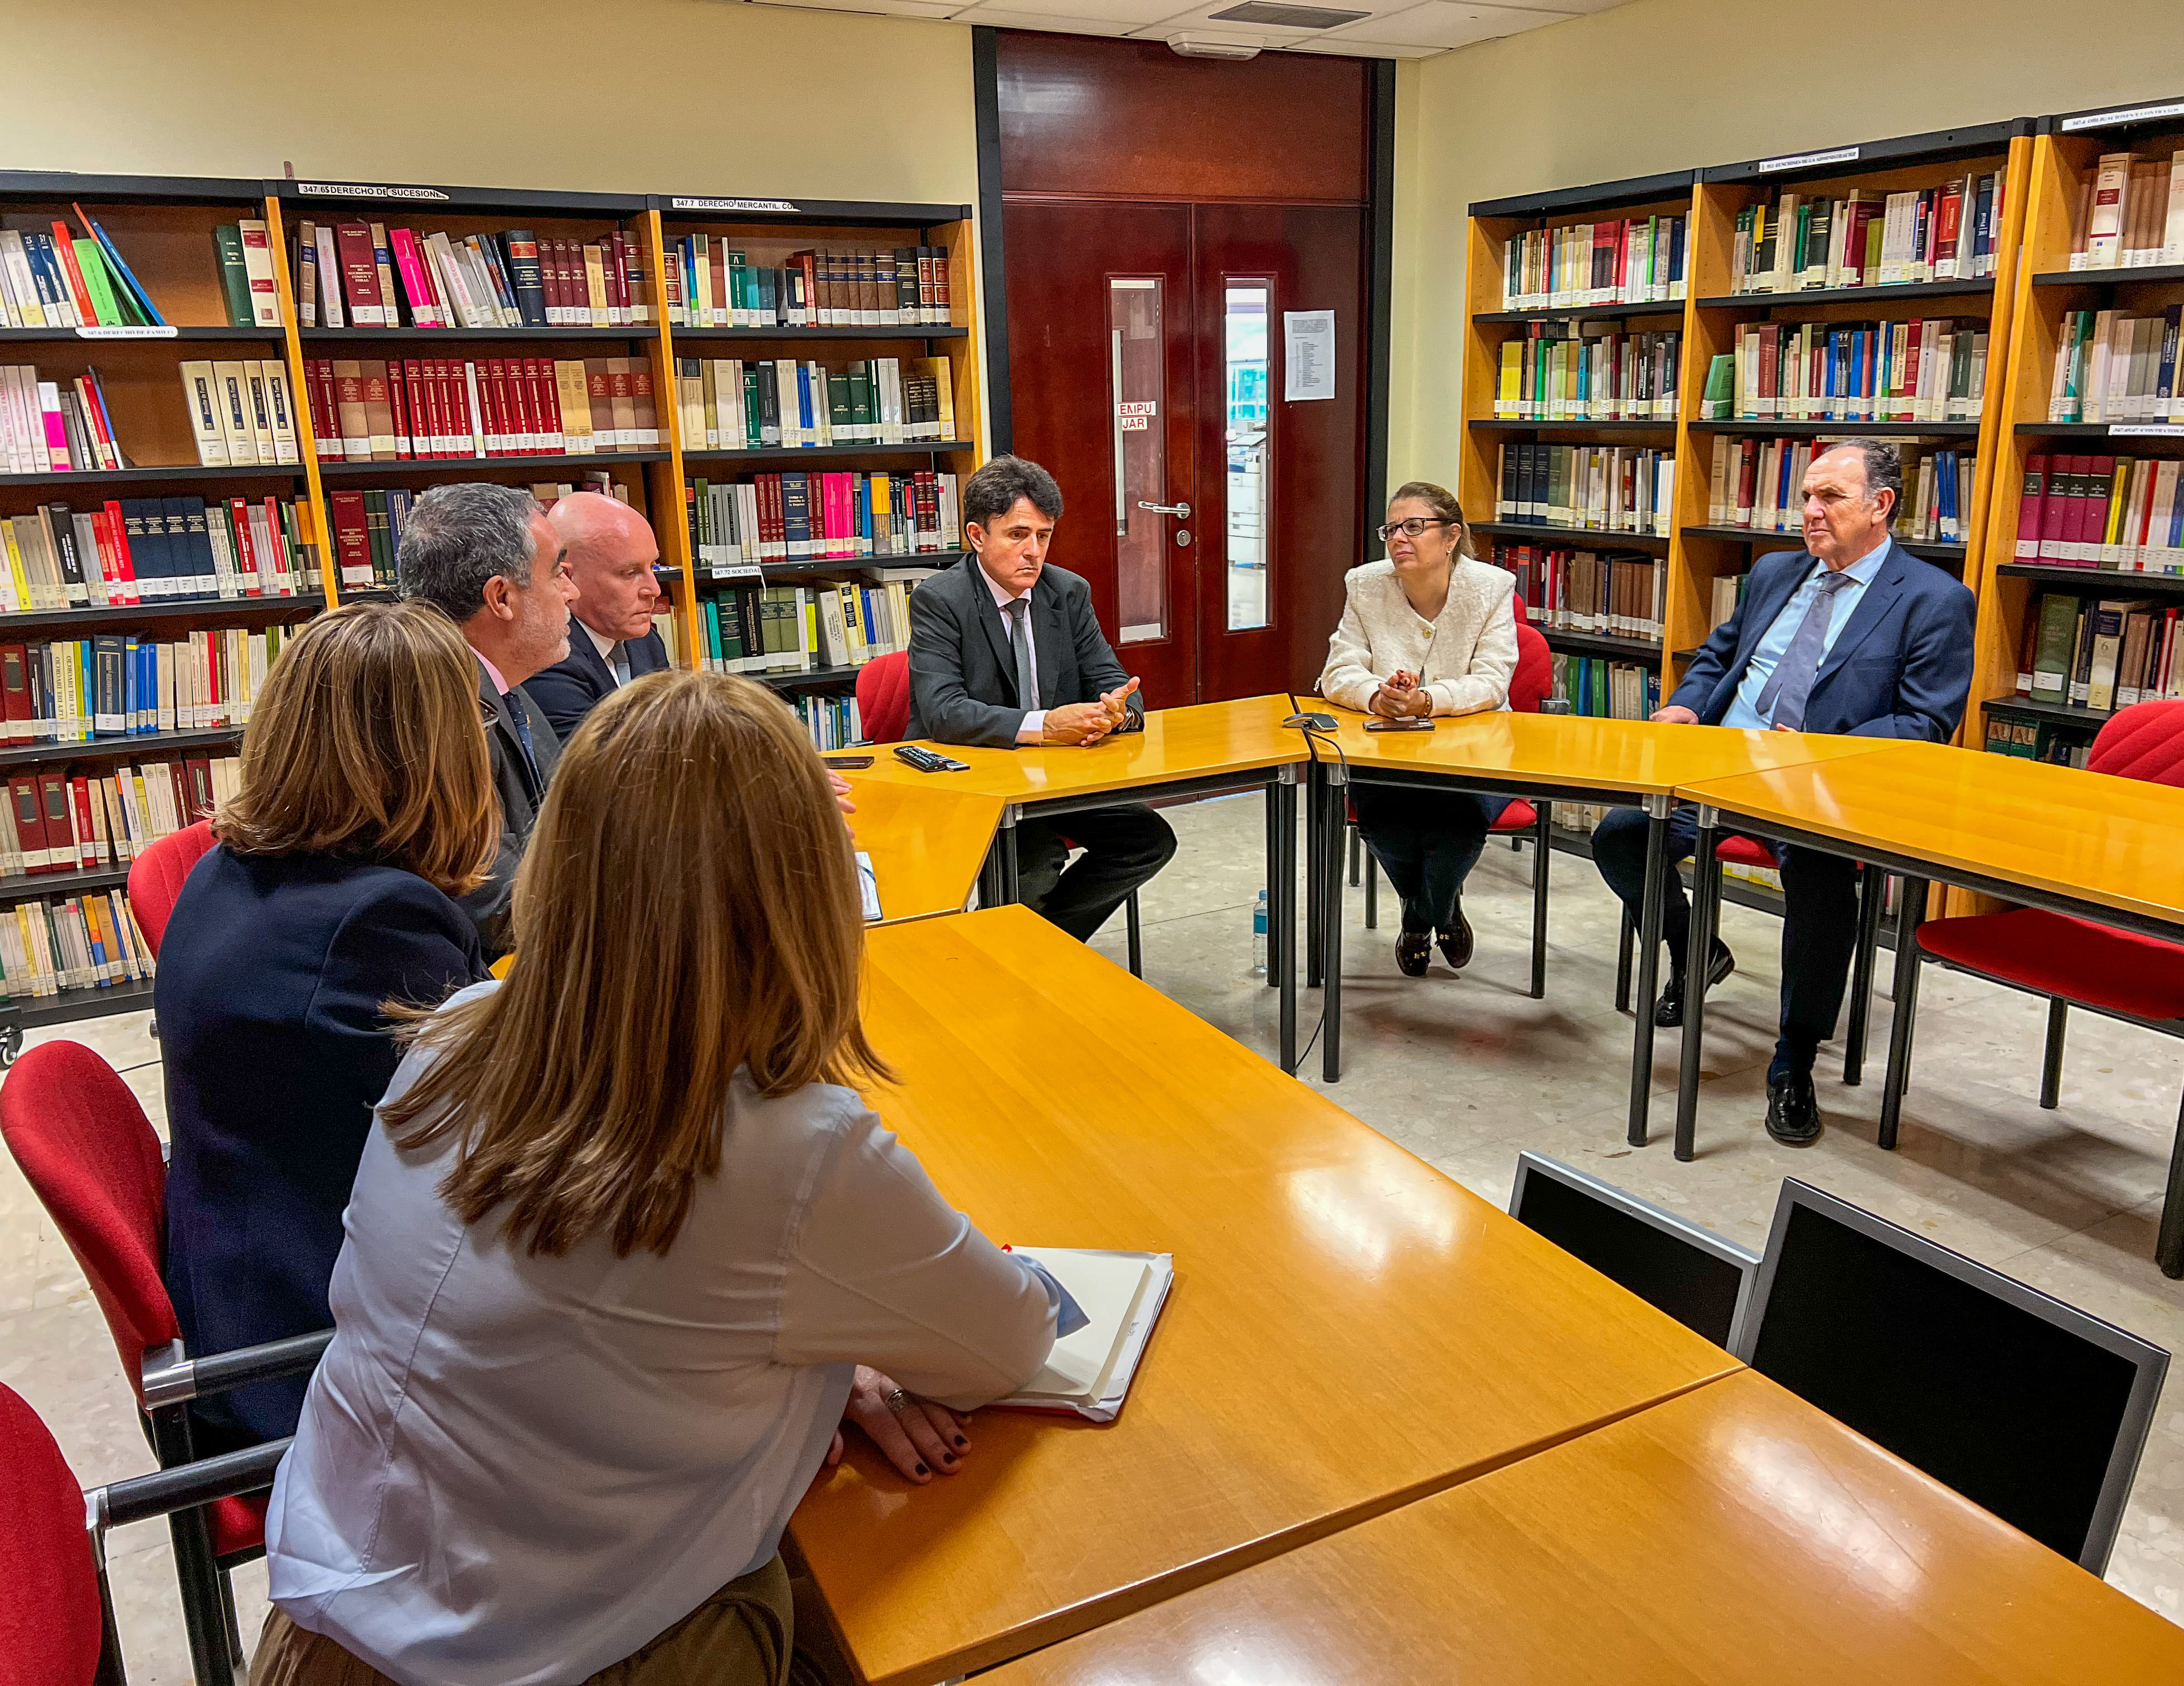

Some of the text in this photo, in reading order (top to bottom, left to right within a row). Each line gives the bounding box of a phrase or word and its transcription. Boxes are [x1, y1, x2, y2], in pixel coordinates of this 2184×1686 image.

[331, 186, 374, 195] DERECHO
[391, 189, 443, 198] SUCESIONE
[1123, 418, 1144, 429] JAR
